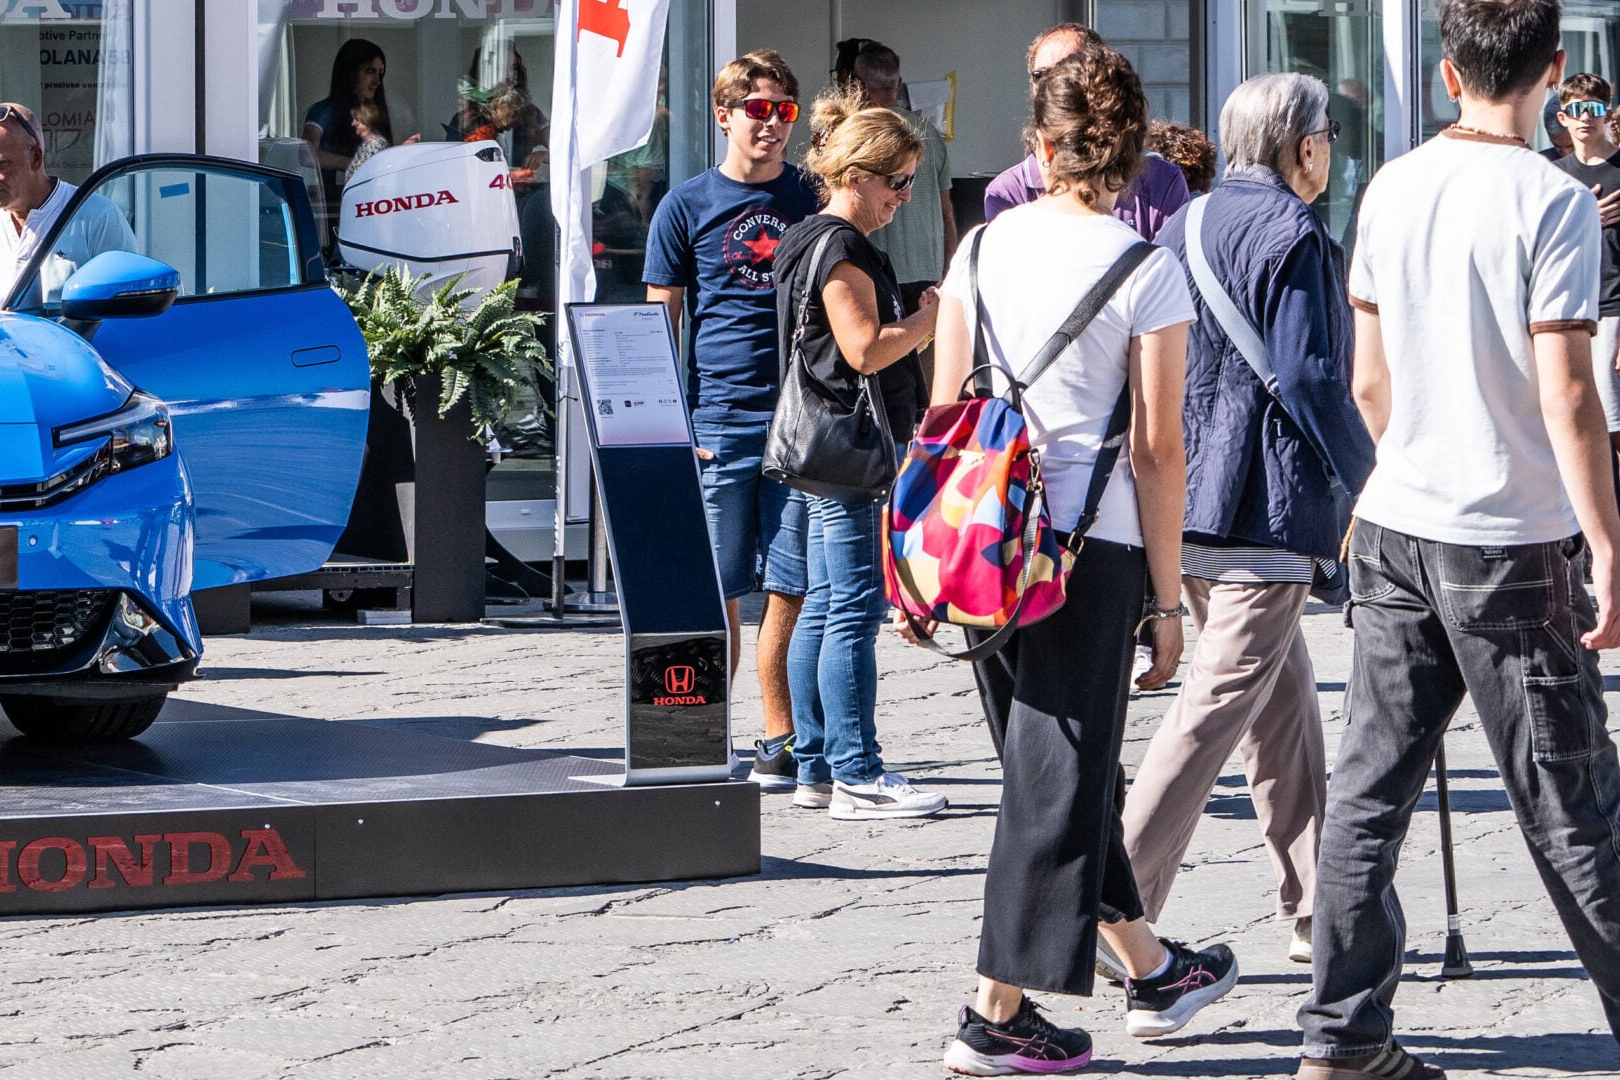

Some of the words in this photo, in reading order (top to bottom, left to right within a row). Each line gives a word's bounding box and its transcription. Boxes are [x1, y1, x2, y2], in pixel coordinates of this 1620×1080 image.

[354, 190, 460, 219] HONDA
[733, 214, 789, 241] CONVERS
[738, 264, 758, 282] ALL
[653, 695, 707, 706] HONDA
